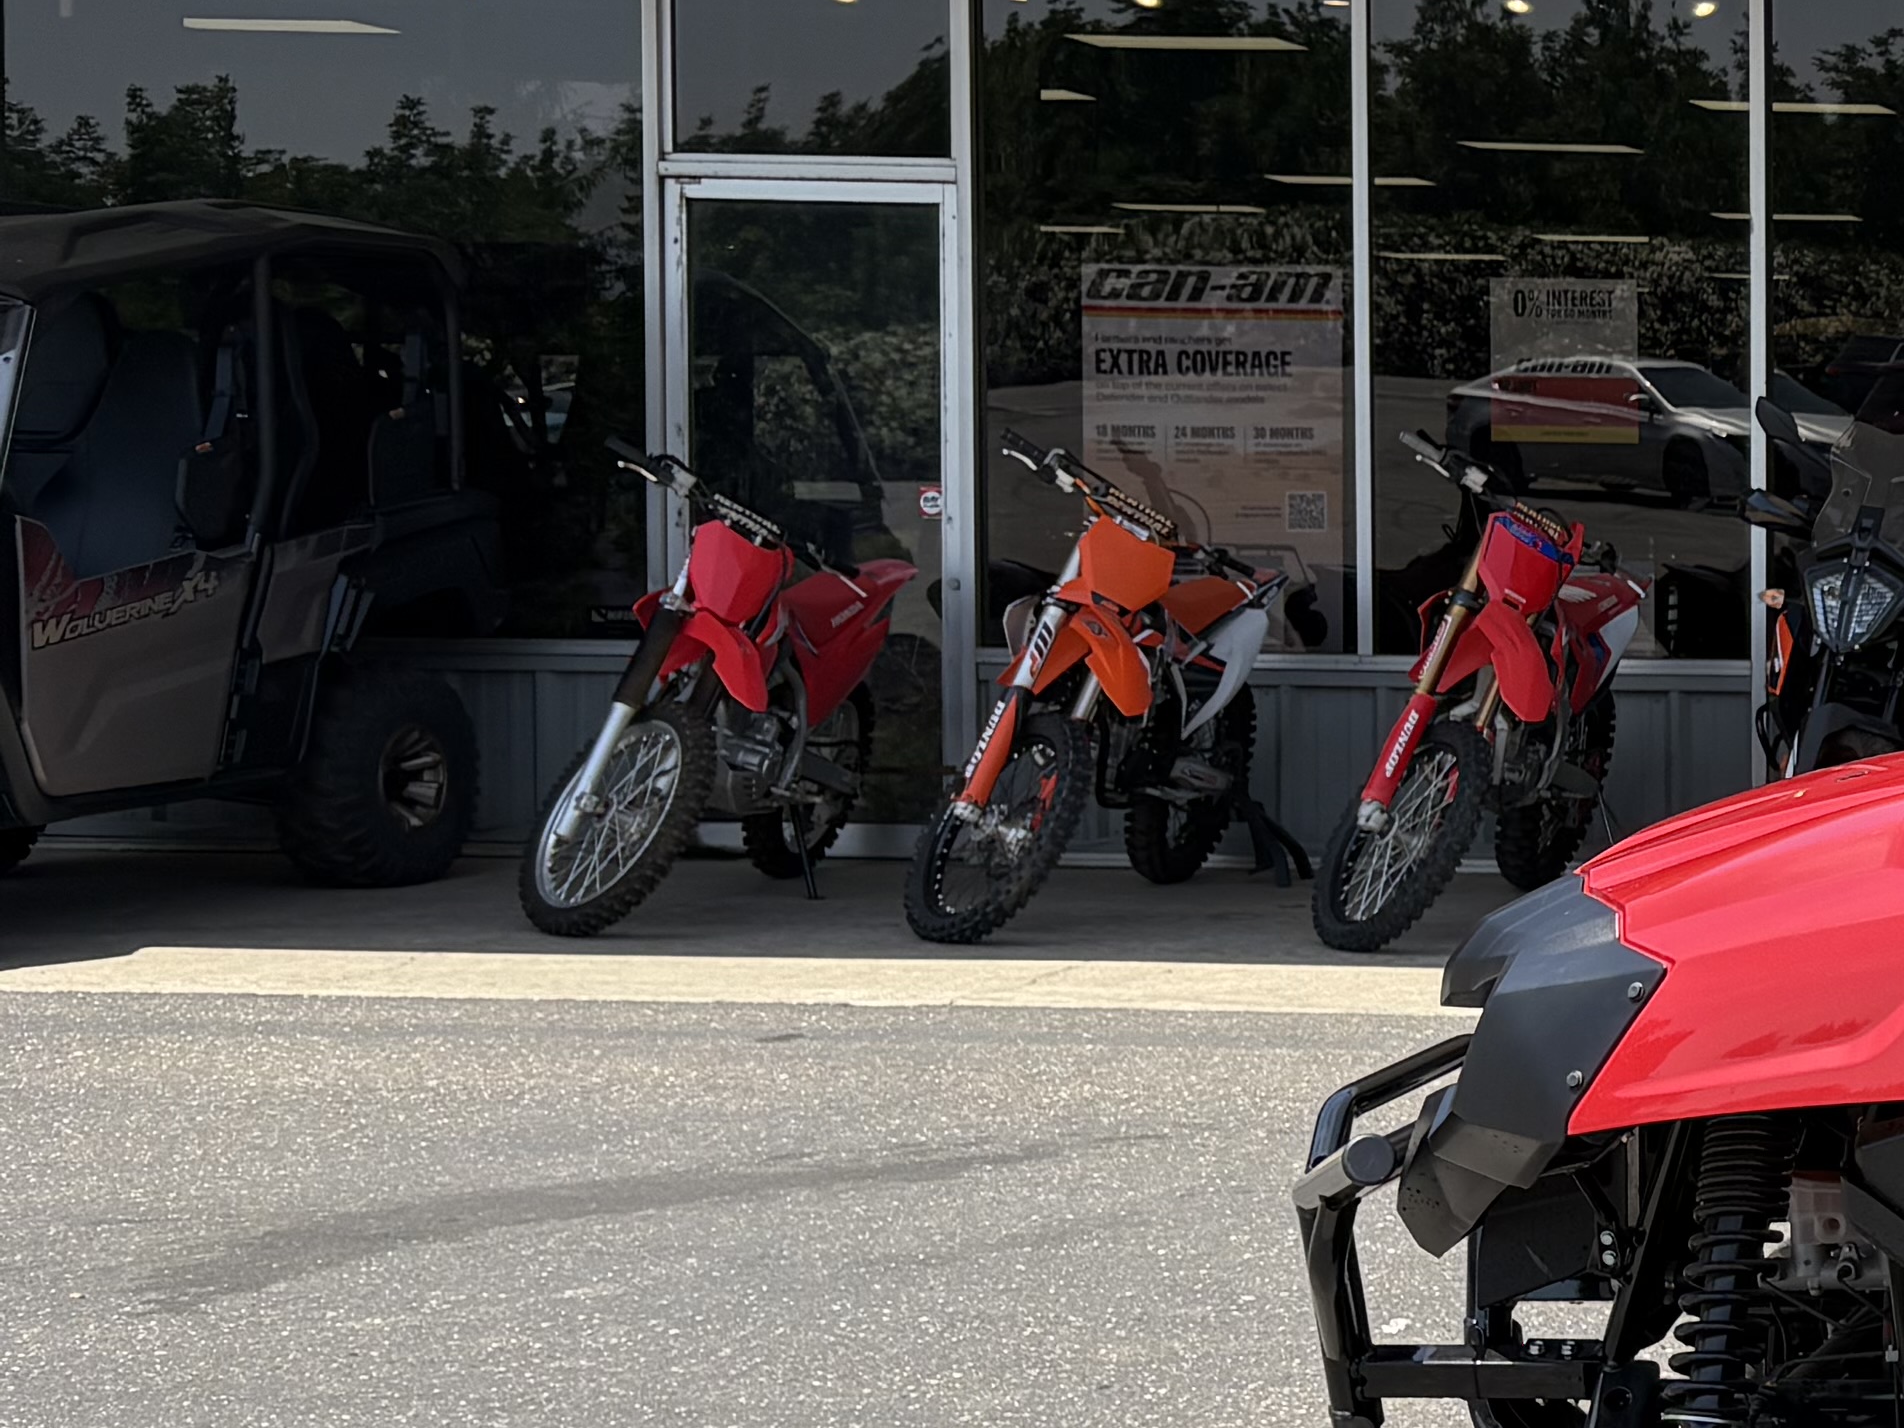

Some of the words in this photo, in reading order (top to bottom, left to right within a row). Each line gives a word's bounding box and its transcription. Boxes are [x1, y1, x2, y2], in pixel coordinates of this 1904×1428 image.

[1086, 268, 1334, 304] can-am
[1513, 289, 1543, 318] 0%
[1546, 289, 1614, 308] INTEREST
[1095, 349, 1169, 376] EXTRA
[1176, 350, 1294, 378] COVERAGE
